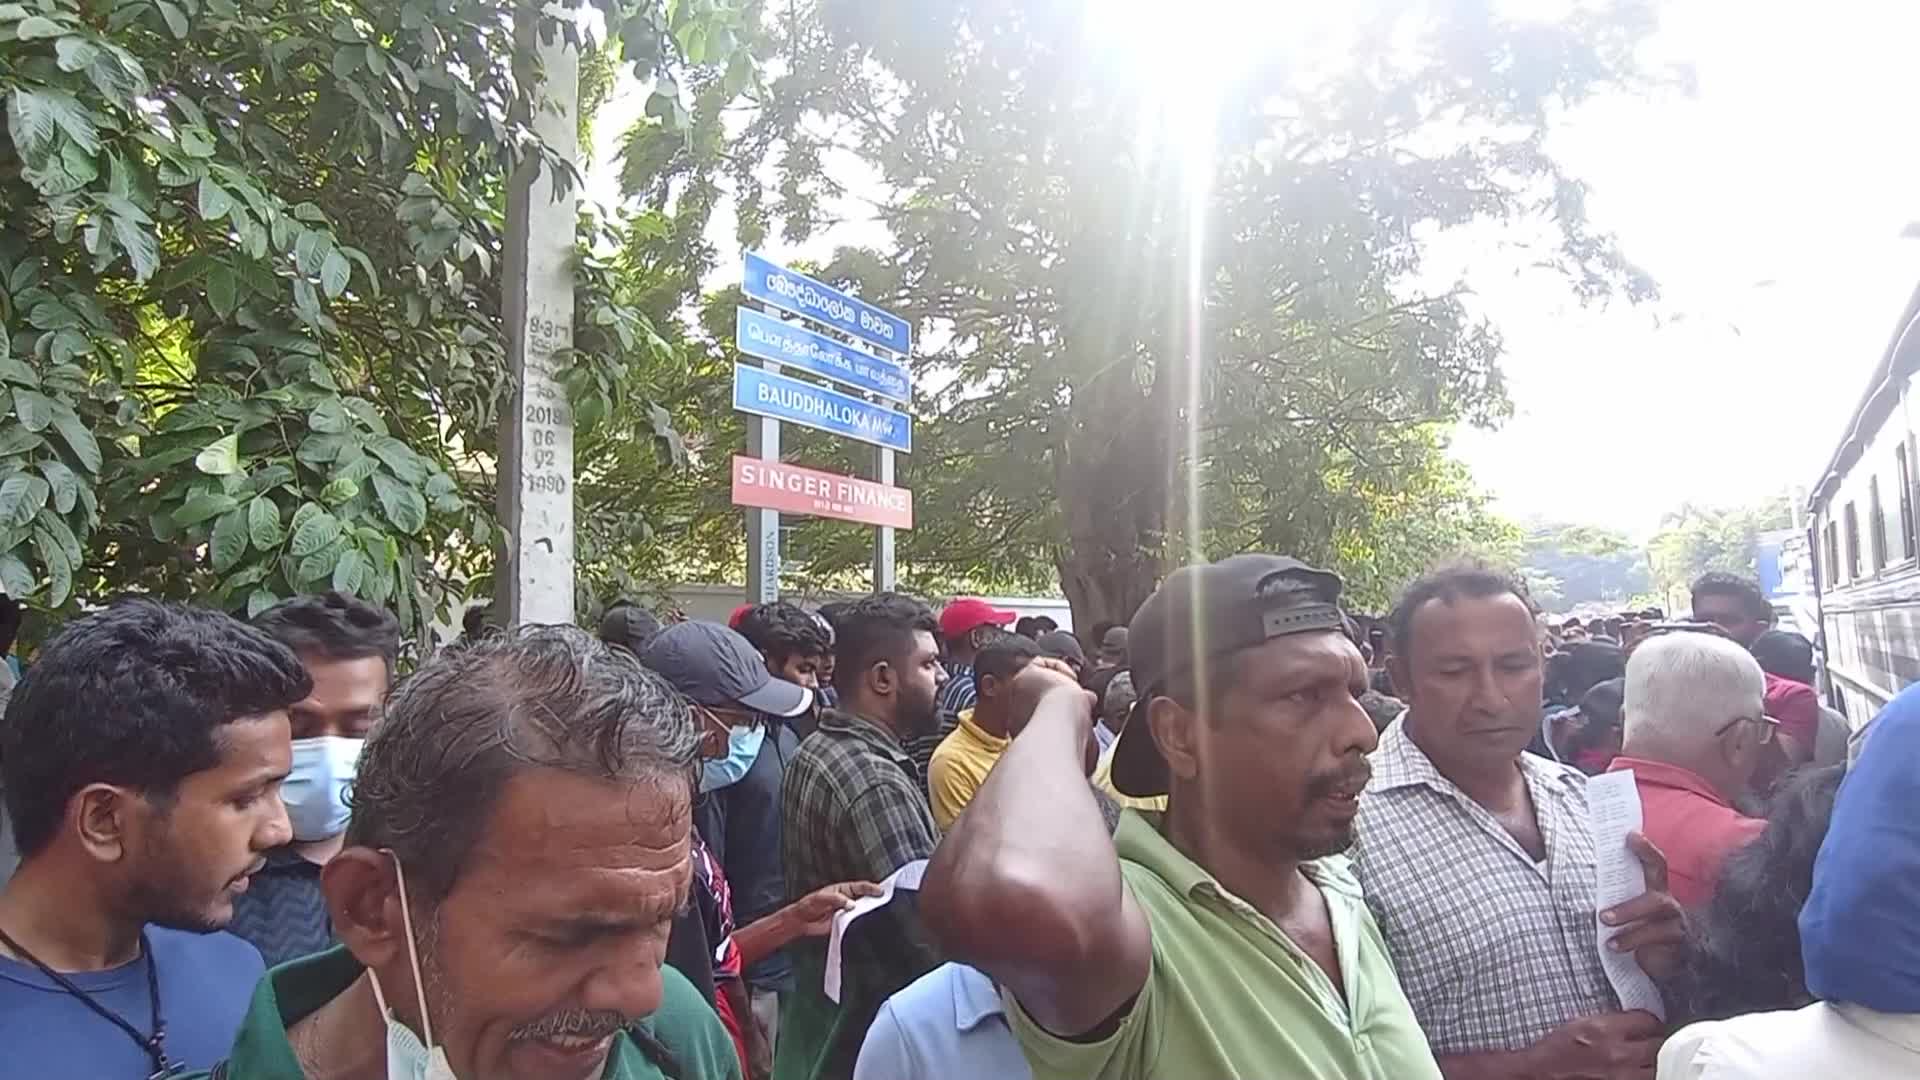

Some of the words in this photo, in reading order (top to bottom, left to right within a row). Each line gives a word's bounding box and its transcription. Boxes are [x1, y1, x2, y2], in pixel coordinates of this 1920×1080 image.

[860, 310, 894, 340] මාවත
[758, 383, 870, 432] BAUDDHALOKA
[740, 464, 831, 499] SINGER
[837, 482, 906, 513] FINANCE
